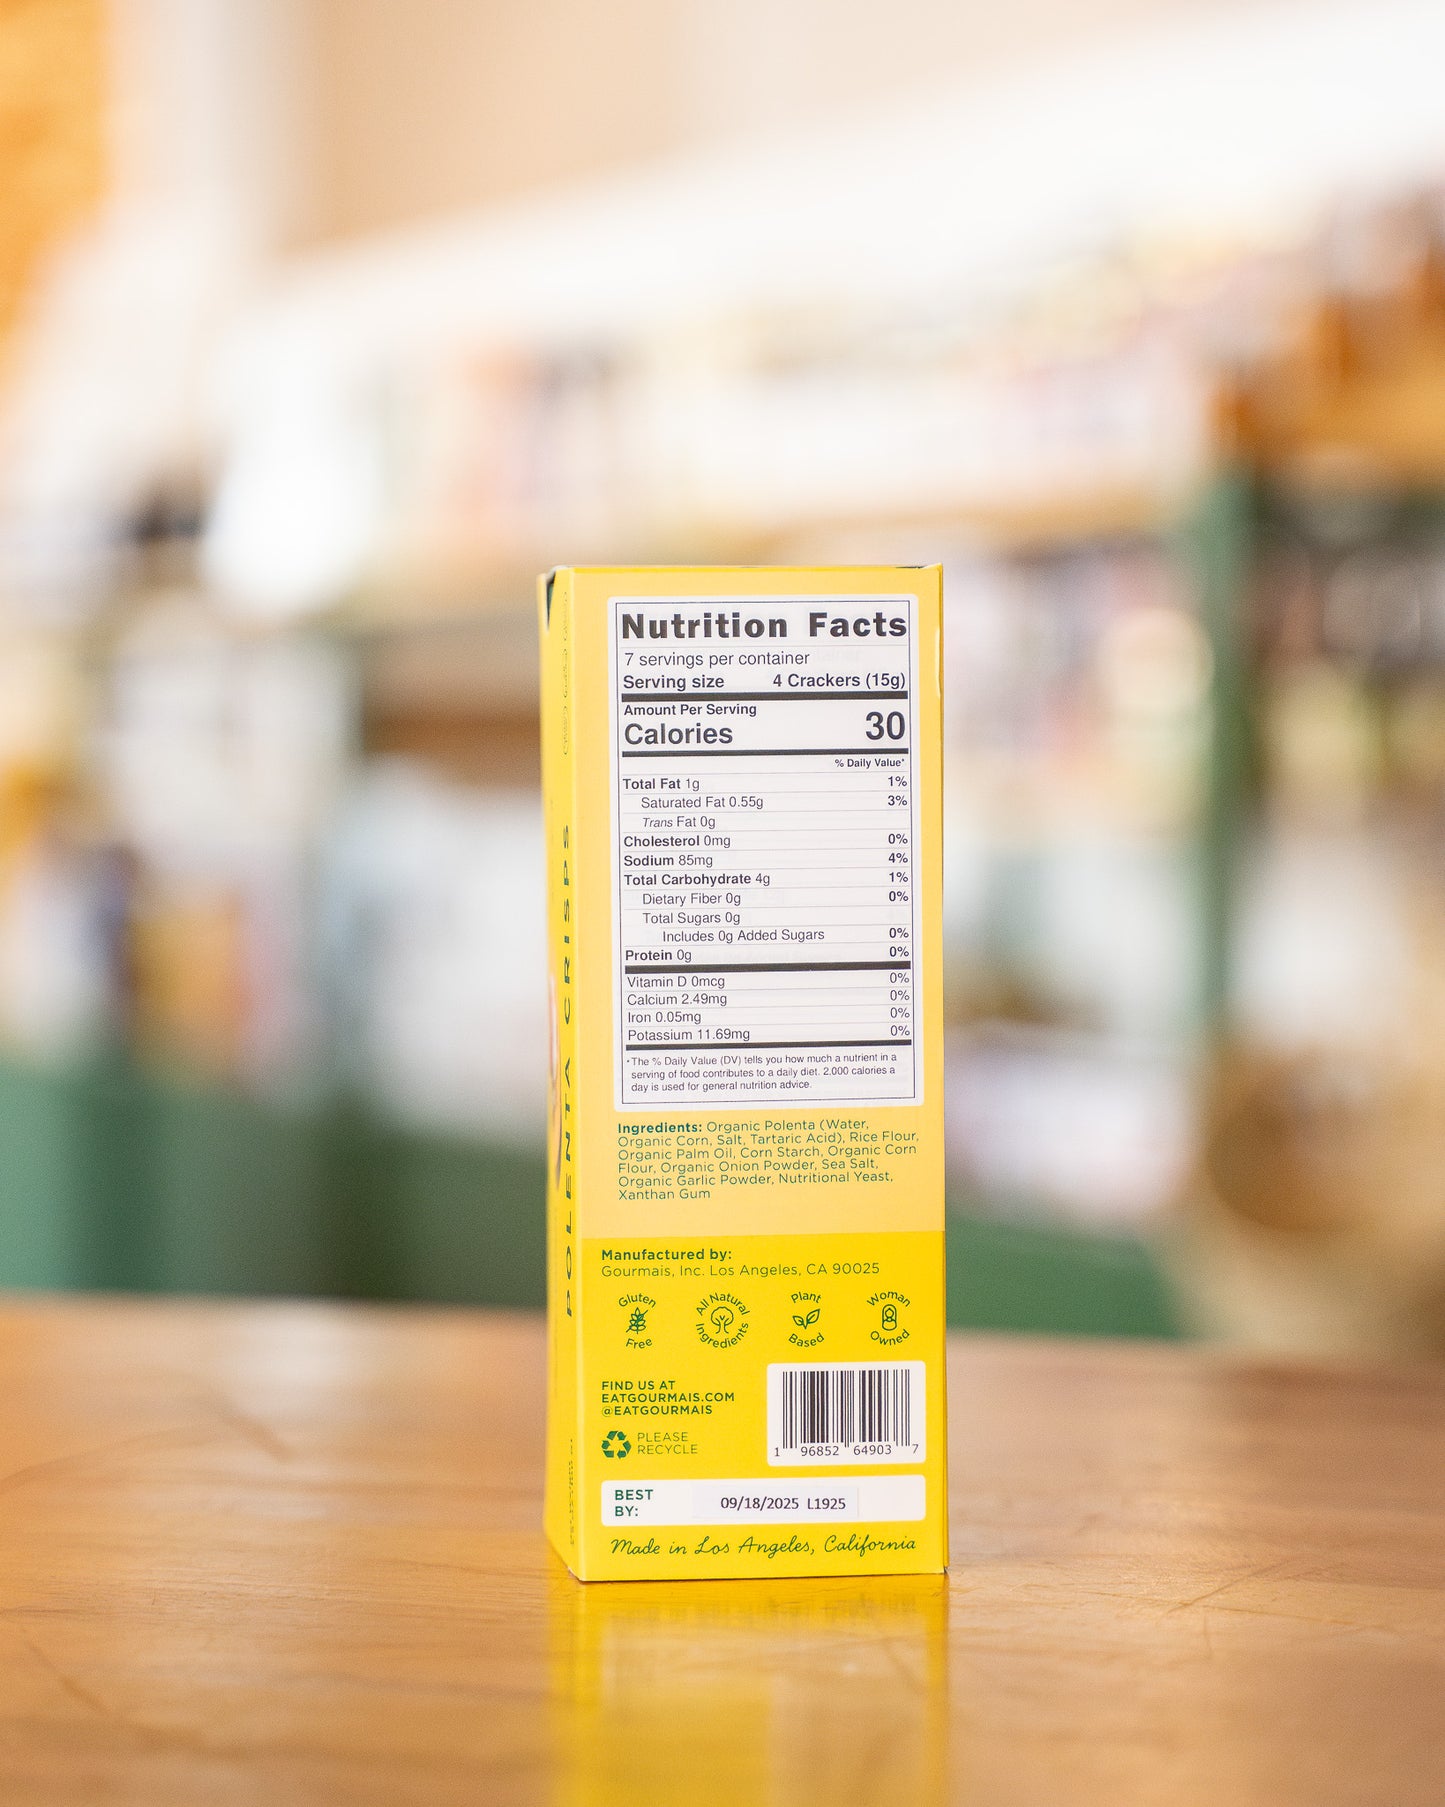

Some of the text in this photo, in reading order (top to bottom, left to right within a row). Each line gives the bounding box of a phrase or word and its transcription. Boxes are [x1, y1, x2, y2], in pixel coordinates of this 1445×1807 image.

[622, 612, 907, 639] Nutrition Facts
[624, 651, 810, 669] 7 servings per container
[623, 674, 724, 692] Serving size
[773, 672, 905, 690] 4 Crackers (15g)
[624, 703, 757, 717] Amount Per Serving
[866, 711, 905, 740] 30
[625, 722, 733, 745] Calories
[834, 759, 844, 767] %
[847, 758, 871, 769] Daily
[622, 778, 700, 792] Total Fat 1g
[888, 776, 908, 787] 1%
[641, 796, 763, 810] Saturated Fat 0.55g
[888, 795, 908, 806] 3%
[643, 816, 715, 830] Trans Fat 0g
[624, 835, 730, 849] Cholesterol 0mg
[888, 833, 908, 844] 0%
[624, 854, 713, 868] Sodium 85mg
[888, 852, 908, 863] 4%
[624, 873, 770, 887] Total Carbohydrate 4g
[889, 872, 909, 883] 1%
[643, 892, 741, 907] Dietary Fiber 0g
[889, 891, 909, 902] 0%
[642, 912, 740, 926] Total Sugars 0g
[663, 929, 825, 944] Includes 0g Added Sugars
[889, 927, 909, 938] 0%
[626, 949, 692, 963] Protein 0g
[889, 946, 909, 957] 0%
[627, 976, 725, 989] Vitamin D 0mcg
[890, 972, 910, 983] 0%
[627, 993, 727, 1007] Calcium 2.49mg
[890, 989, 910, 1001] 0%
[628, 1011, 701, 1025] Iron 0.05mg
[890, 1007, 910, 1019] 0%
[628, 1028, 750, 1042] Potassium 11.69mg
[890, 1025, 910, 1036] 0%
[652, 1057, 662, 1066] %
[664, 1056, 687, 1067] Daily
[690, 1056, 717, 1065] Value
[720, 1055, 741, 1066] (DV)
[744, 1055, 763, 1064] tells
[765, 1056, 782, 1066] you
[785, 1055, 804, 1063] how
[807, 1054, 832, 1063] much
[843, 1053, 878, 1062] nutrient
[880, 1053, 888, 1061] in
[891, 1054, 897, 1062] a
[563, 824, 573, 1317] POLENTA CRISPS
[618, 1122, 702, 1136] Ingredients:
[706, 1121, 760, 1134] Organic
[765, 1120, 815, 1131] Polenta
[618, 1130, 919, 1149] Organic Corn, Salt, Tartaric Acid), Rice Flour,
[618, 1144, 916, 1162] Organic Palm Oil, Corn Starch, Organic Corn
[618, 1158, 878, 1175] Flour, Organic Onion Powder, Sea Salt,
[618, 1171, 893, 1189] Organic Garlic Powder, Nutritional Yeast,
[619, 1188, 710, 1200] Xanthan Gum
[602, 1248, 731, 1262] Manufactured by:
[601, 1262, 880, 1278] Gourmais, Inc. Los Angeles, CA 90025
[618, 1293, 656, 1308] Gluten
[696, 1292, 750, 1316] All Natural
[791, 1291, 821, 1304] Plant
[866, 1291, 910, 1307] Woman
[695, 1323, 749, 1349] Ingredients
[788, 1332, 825, 1348] Based
[870, 1328, 910, 1346] Owned
[625, 1338, 652, 1349] Free
[602, 1380, 676, 1390] FIND US AT
[602, 1392, 734, 1403] EATGOURMAIS.COM
[602, 1405, 712, 1416] @EATGOURMAIS
[637, 1431, 688, 1442] PLEASE
[637, 1444, 698, 1455] RECYCLE
[775, 1443, 919, 1457] 1 96852 64903 7
[615, 1489, 653, 1501] BEST
[721, 1496, 799, 1511] 09/18/2025
[615, 1506, 638, 1517] BY:
[611, 1533, 916, 1559] Made in Los Angeles, California
